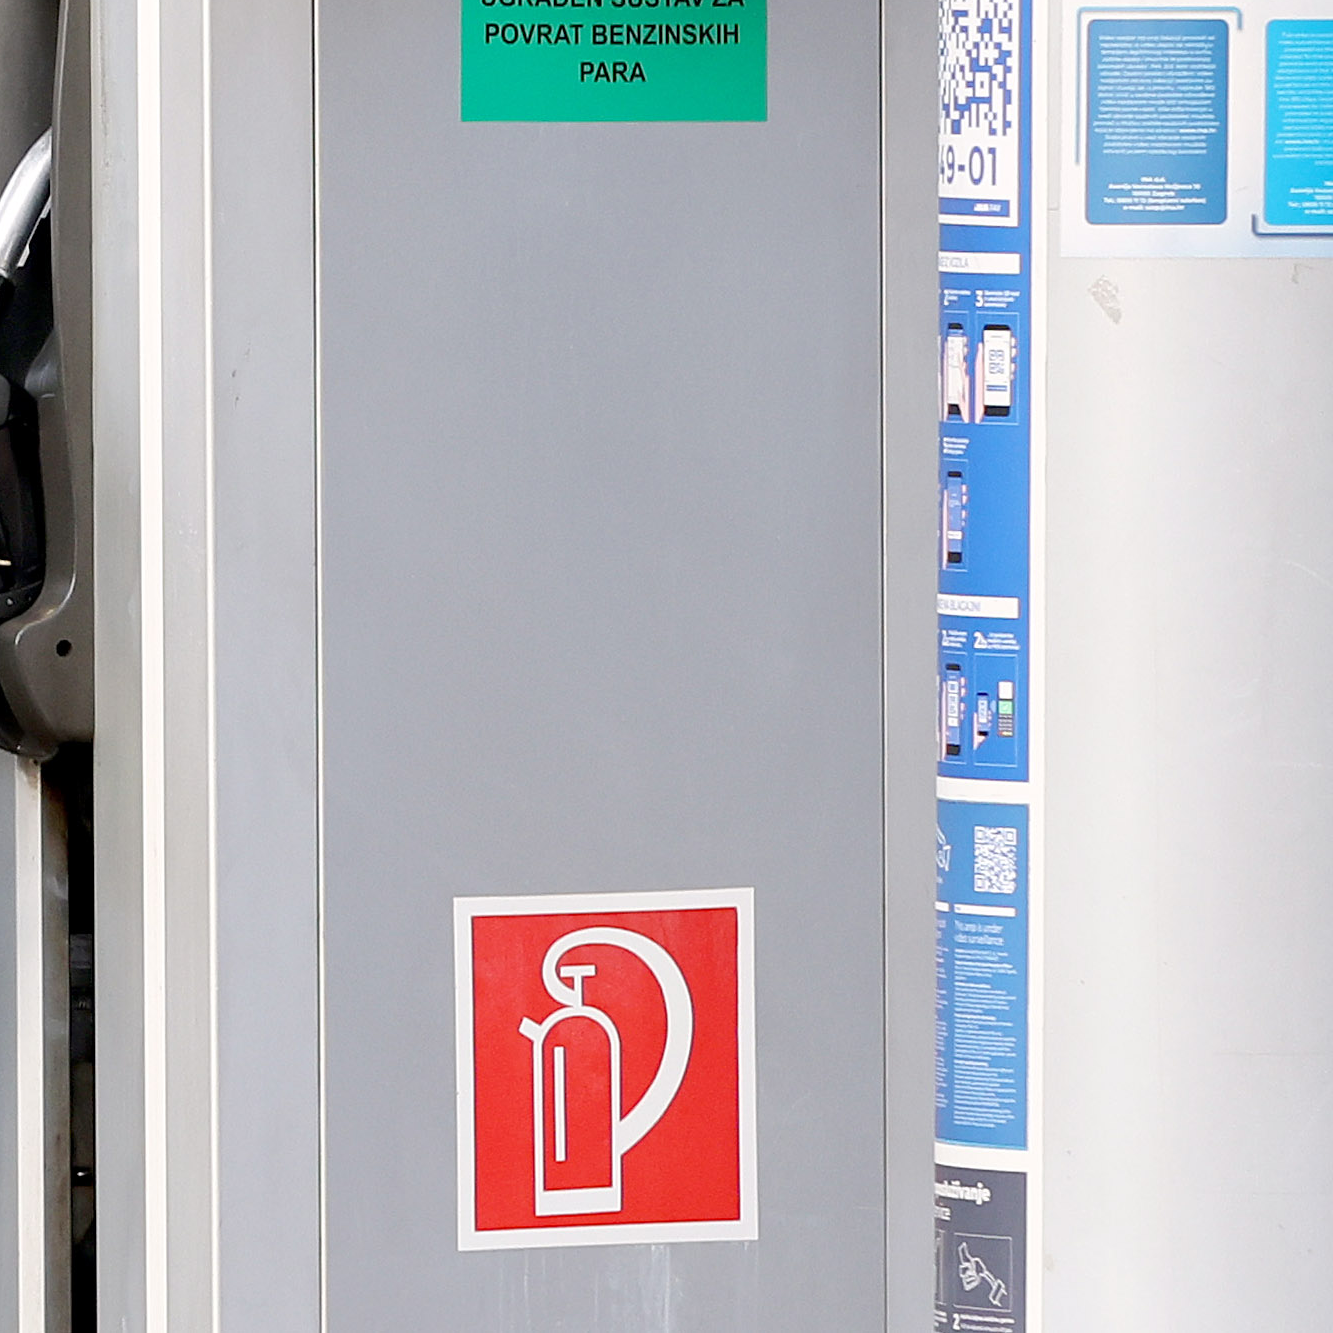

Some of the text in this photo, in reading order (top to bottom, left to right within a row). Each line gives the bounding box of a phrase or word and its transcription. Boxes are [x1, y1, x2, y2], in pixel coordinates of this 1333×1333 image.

[485, 23, 740, 45] POVRAT BENZINSKIH
[579, 61, 646, 83] PARA
